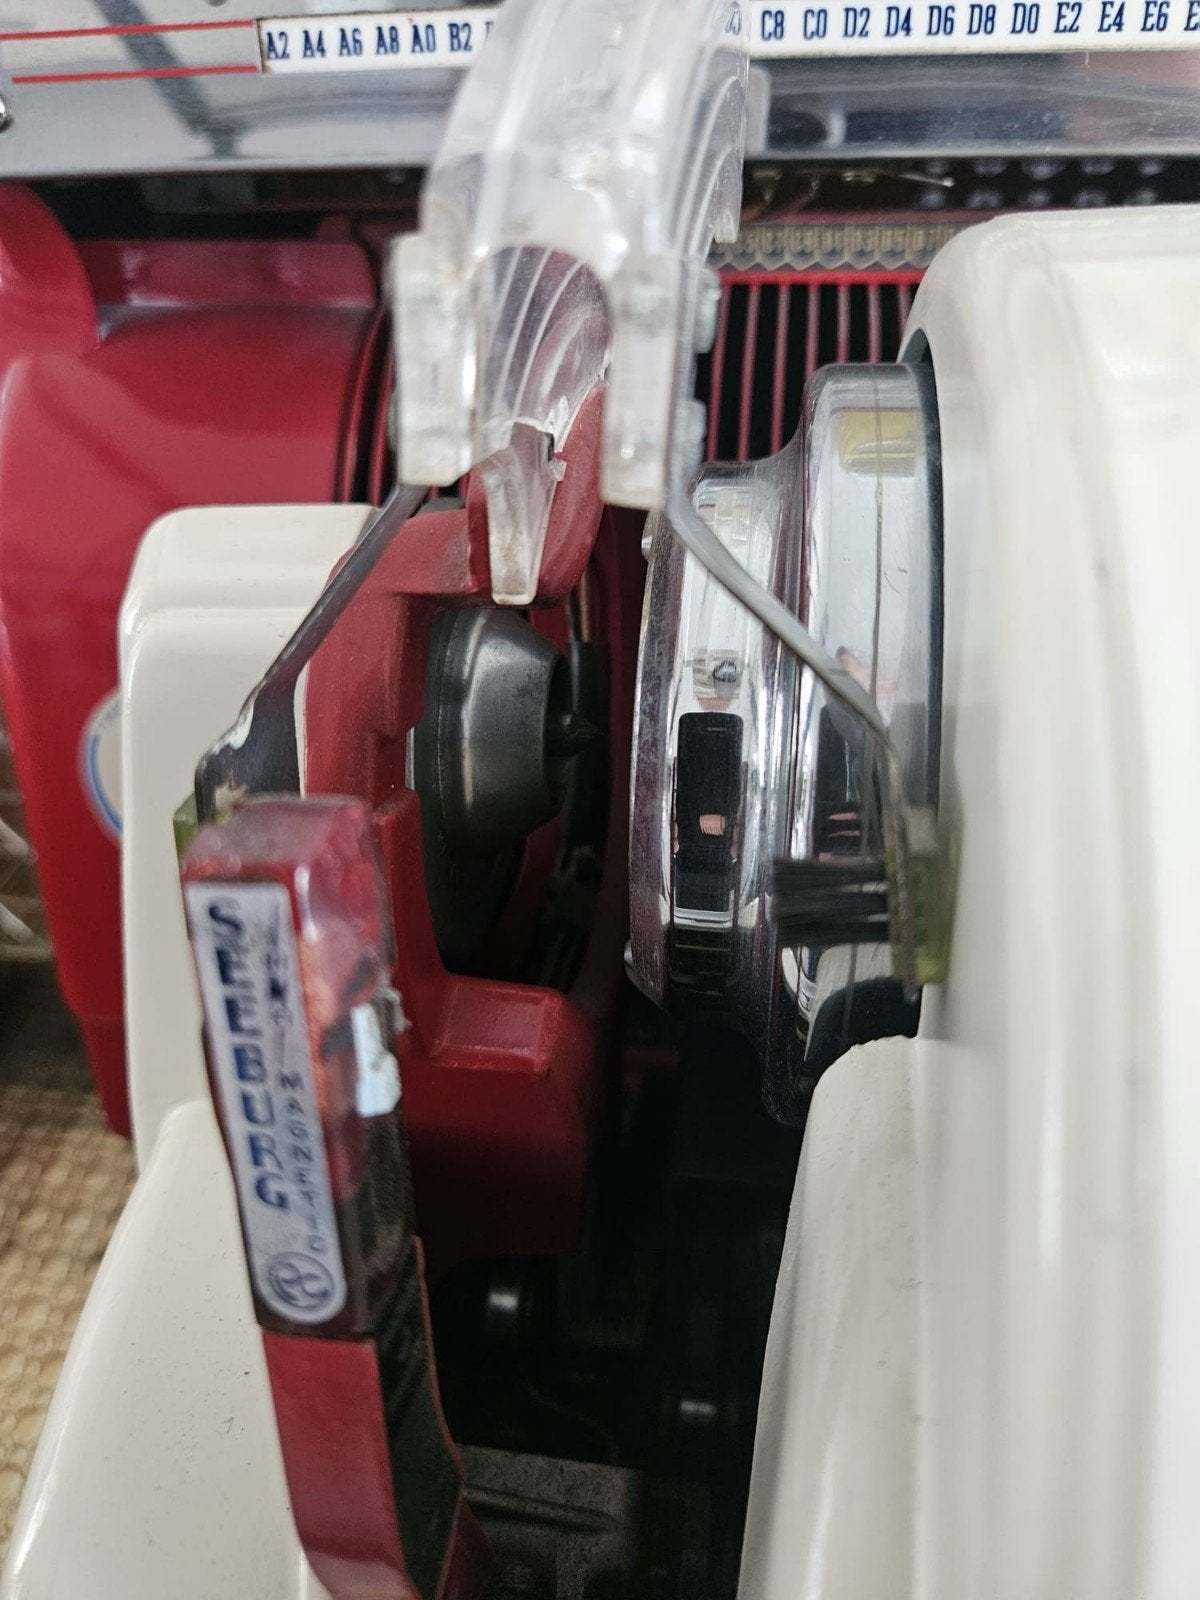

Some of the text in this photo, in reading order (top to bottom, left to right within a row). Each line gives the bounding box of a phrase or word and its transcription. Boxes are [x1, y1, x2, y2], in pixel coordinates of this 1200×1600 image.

[265, 30, 290, 61] A2
[302, 29, 326, 59] A4
[338, 28, 363, 56] A6
[375, 26, 400, 55] A8
[409, 24, 437, 53] A0
[448, 22, 472, 51] B2
[761, 9, 785, 40] C8
[803, 8, 828, 40] C0
[843, 7, 870, 38] D2
[885, 6, 912, 37] D4
[927, 5, 955, 36] D6
[967, 3, 996, 35] D8
[1010, 2, 1039, 34] D0
[1053, 1, 1083, 34] E2
[1097, 0, 1125, 32] E4
[1140, 0, 1170, 32] E6
[1184, 0, 1200, 31] E
[209, 900, 289, 1211] SEEBURG
[278, 1070, 328, 1255] MAGNETIC
